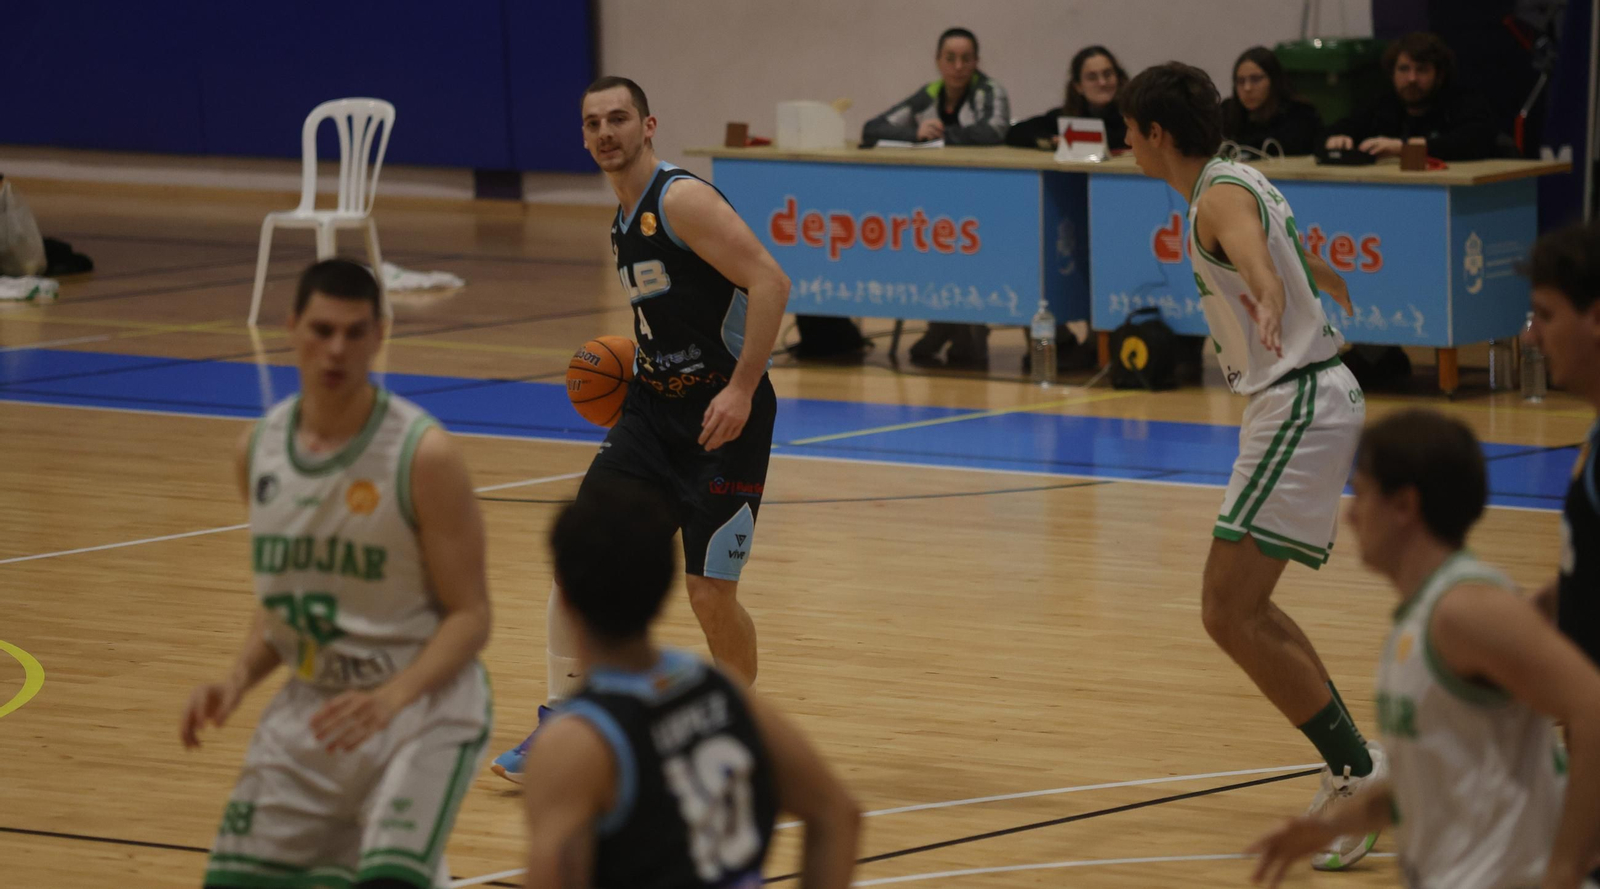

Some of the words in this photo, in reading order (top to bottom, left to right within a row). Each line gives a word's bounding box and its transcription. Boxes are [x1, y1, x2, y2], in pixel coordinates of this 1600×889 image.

[769, 194, 982, 261] deportes
[1152, 212, 1383, 273] dtes
[637, 306, 653, 340] 4
[728, 549, 746, 561] vive
